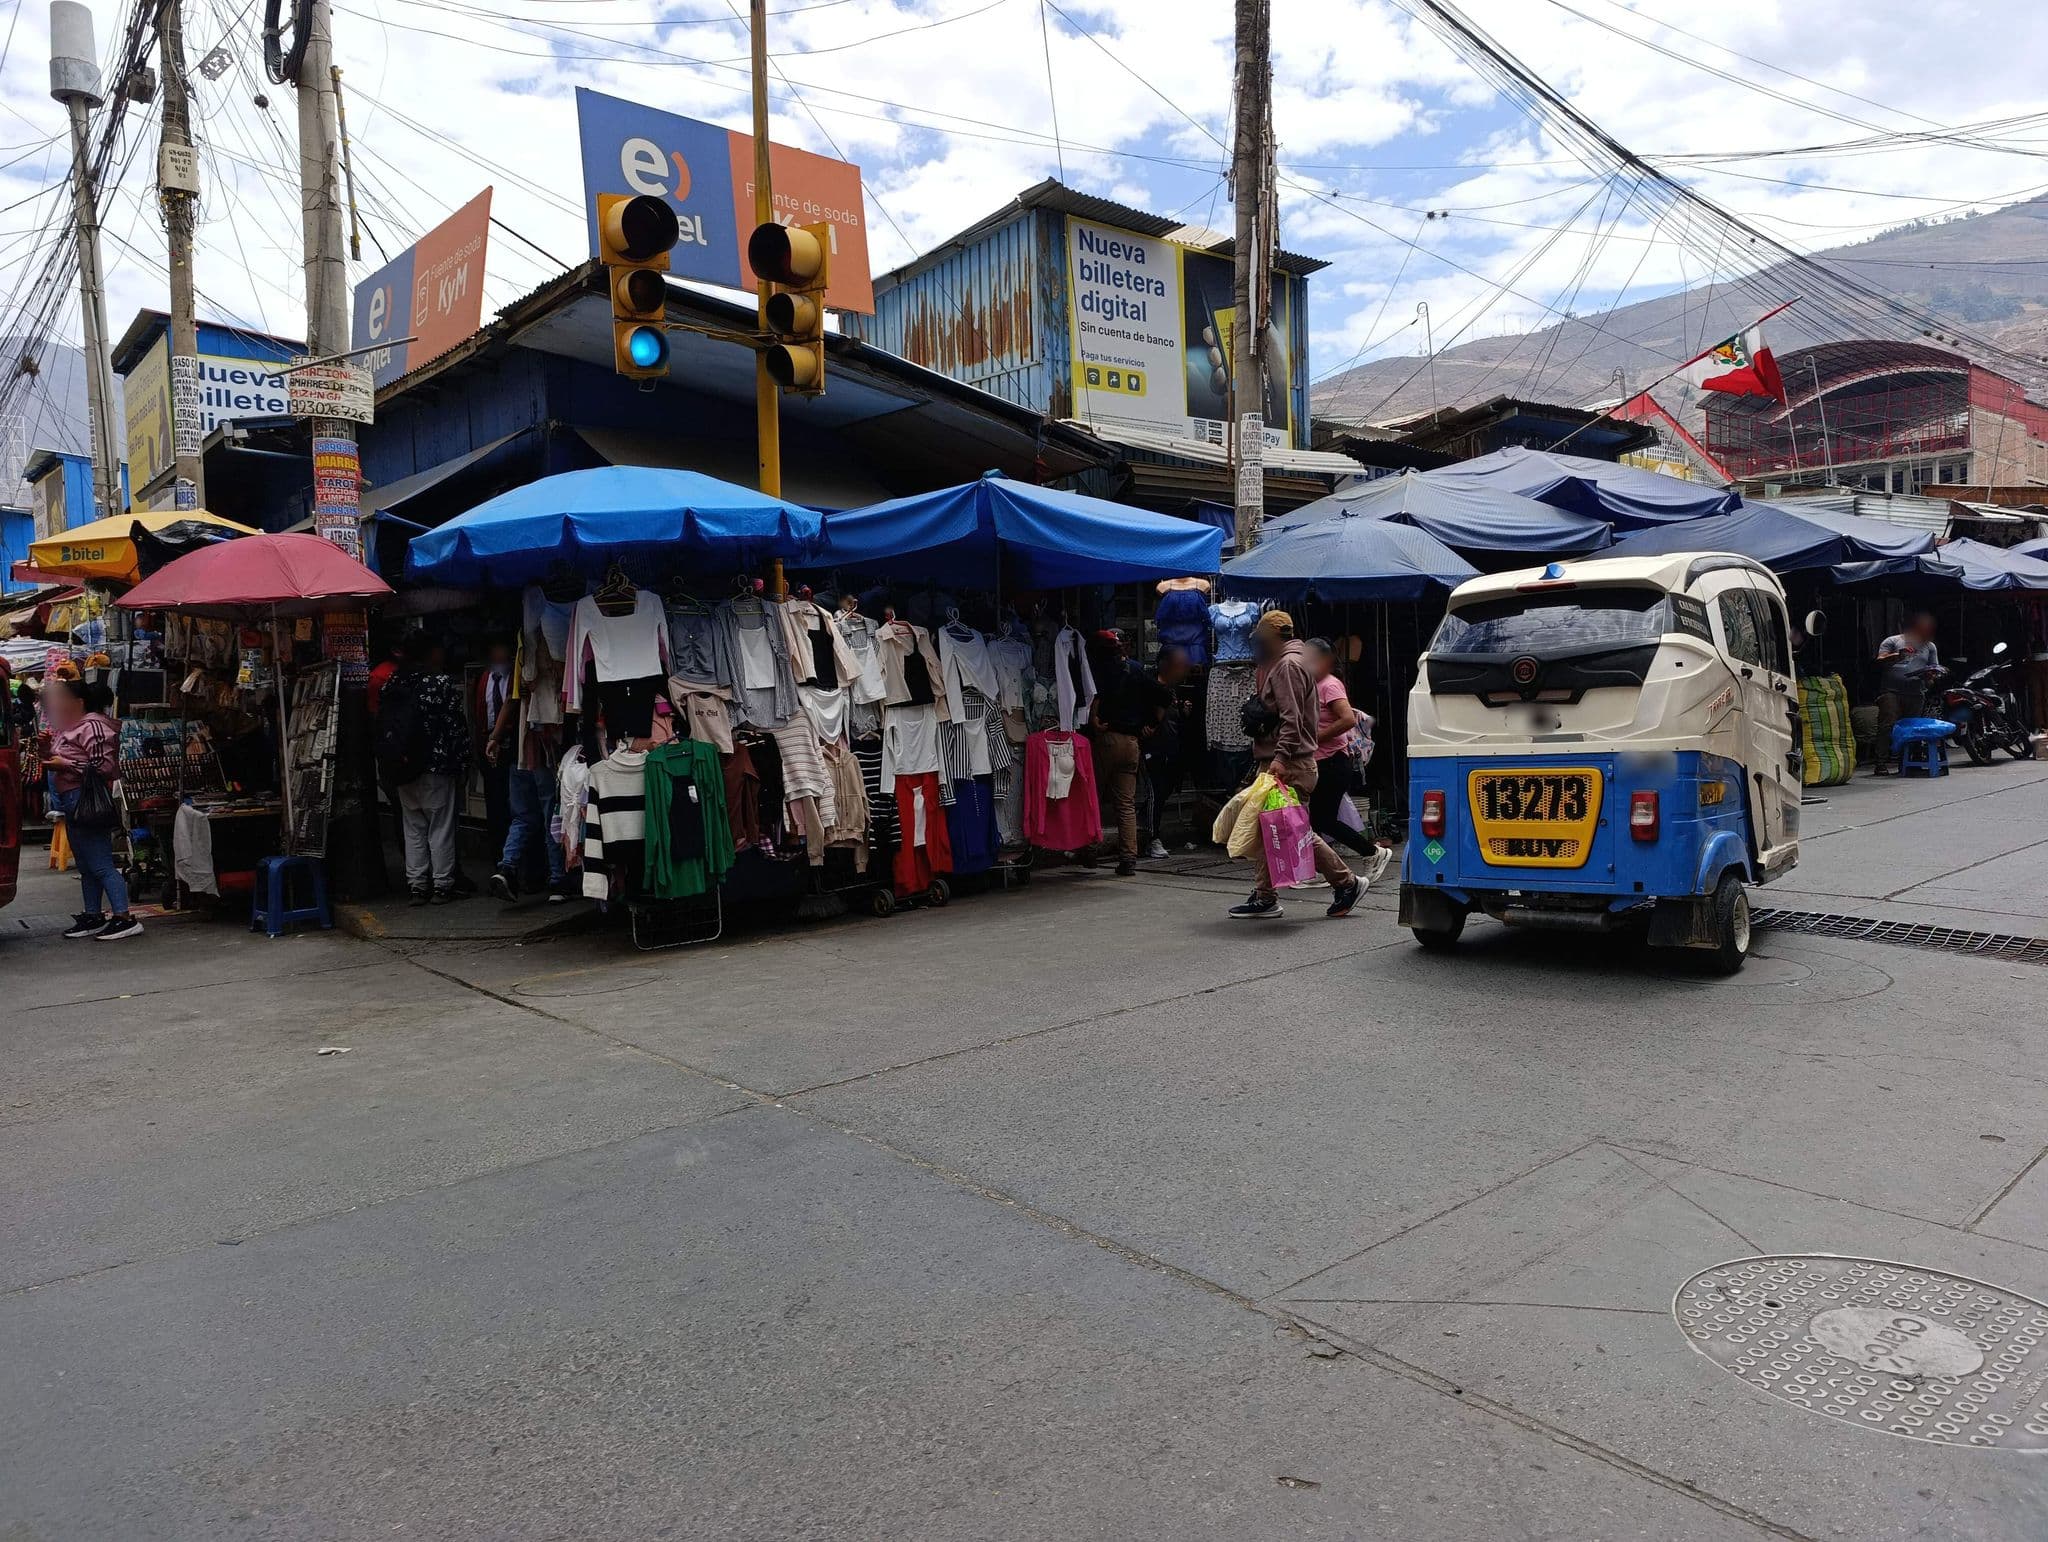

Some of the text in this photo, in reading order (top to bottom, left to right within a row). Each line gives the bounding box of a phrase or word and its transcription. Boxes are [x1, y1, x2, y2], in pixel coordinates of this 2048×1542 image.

[746, 182, 858, 227] Fnte de soda
[430, 257, 453, 281] Fuente
[463, 234, 481, 258] soda
[1078, 228, 1145, 264] Nueva
[437, 262, 468, 316] KyM
[1079, 258, 1165, 297] billetera
[1081, 290, 1147, 322] digital
[1080, 321, 1174, 348] Sin cuenta de banco
[1081, 350, 1145, 368] Paga tus servicios
[289, 377, 330, 390] AMARRES
[333, 382, 345, 392] DE
[291, 398, 369, 421] 923026726
[1262, 430, 1280, 446] iPay
[320, 477, 355, 489] TAROT
[330, 529, 356, 541] ATRASO
[72, 546, 104, 561] bitel
[1481, 776, 1589, 821] 13273
[1427, 848, 1441, 856] LPG
[1863, 1317, 1928, 1356] Claro
